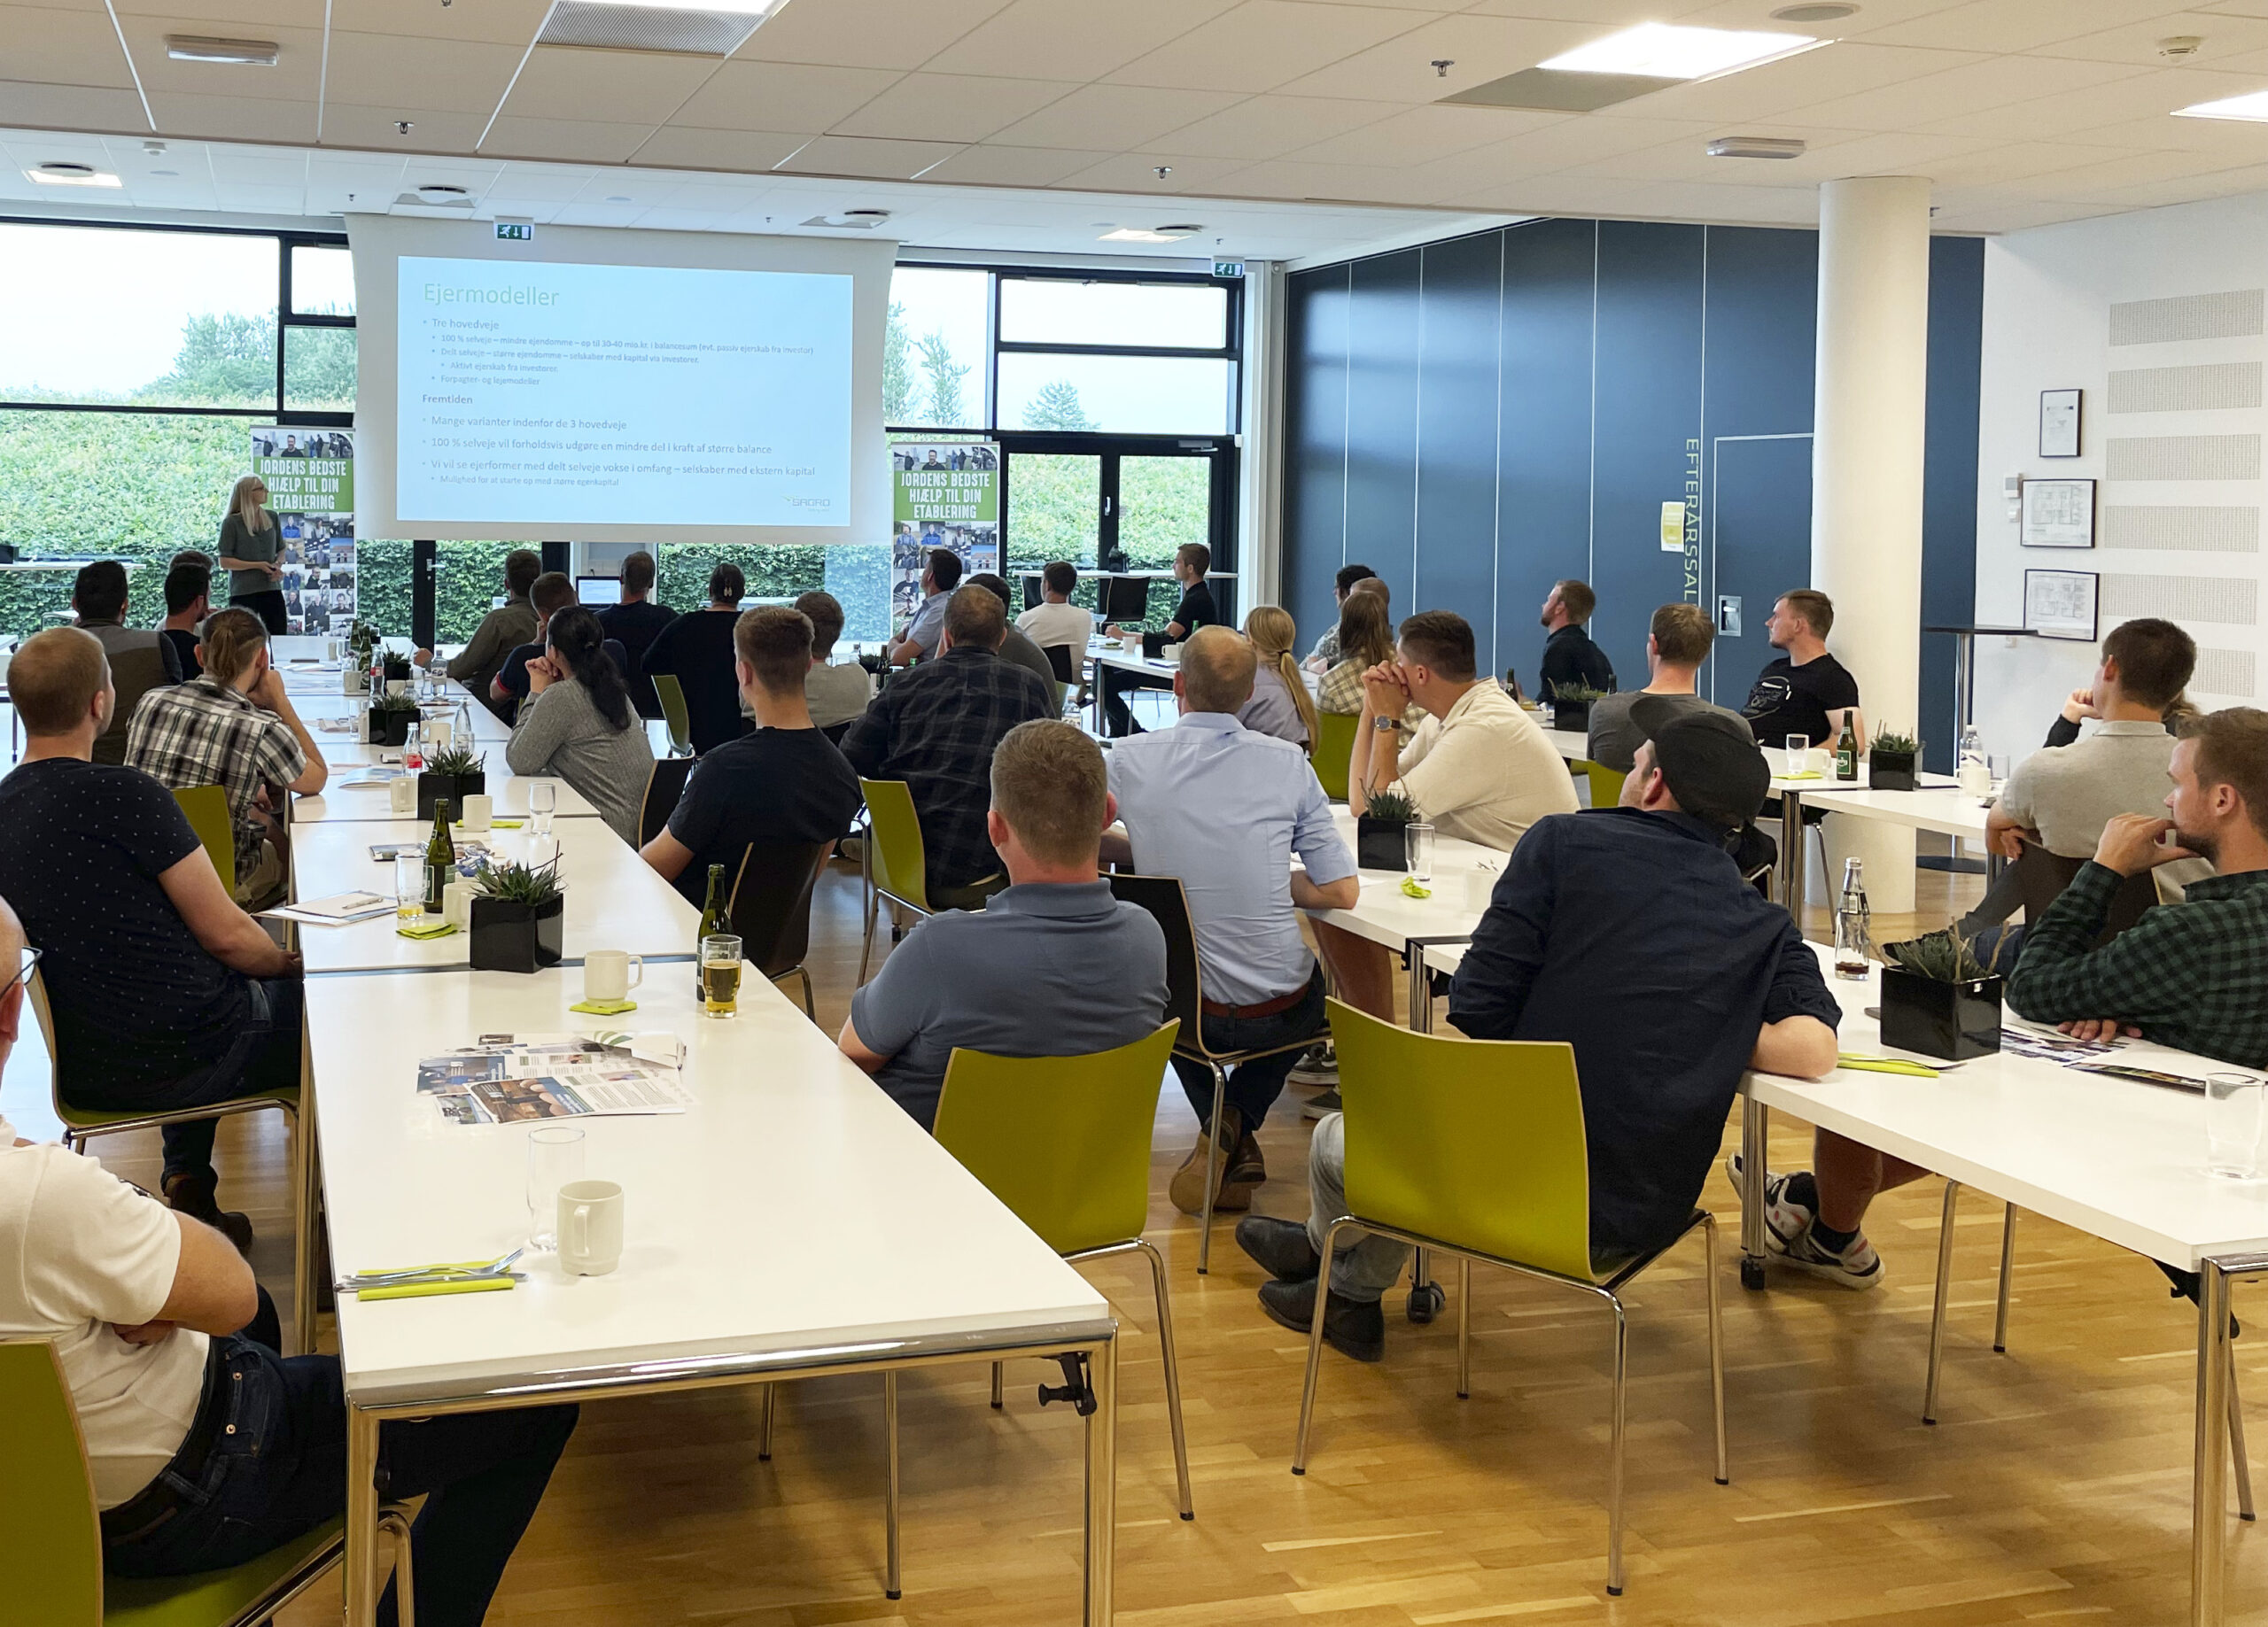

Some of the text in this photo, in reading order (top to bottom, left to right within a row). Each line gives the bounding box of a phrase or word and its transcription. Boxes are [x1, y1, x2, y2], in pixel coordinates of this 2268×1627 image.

[424, 283, 560, 306] Ejermodeller
[432, 319, 500, 332] Tre hovedveje
[466, 336, 492, 346] selveje
[529, 337, 573, 346] ejendomme
[655, 342, 697, 351] balancesum
[740, 345, 770, 353] ejerskab
[422, 394, 473, 404] Fremtiden
[431, 416, 465, 427] Mange
[468, 417, 510, 426] varianter
[513, 418, 554, 428] indenfor
[555, 418, 568, 428] de
[579, 419, 626, 431] hovedveje
[431, 438, 449, 447] 100
[452, 438, 461, 447] %
[463, 438, 496, 449] selveje
[498, 439, 509, 448] vil
[512, 439, 563, 449] forholdsvis
[566, 441, 599, 452] udgøre
[616, 442, 649, 451] mindre
[651, 443, 665, 452] del
[673, 443, 695, 452] kraft
[696, 444, 706, 453] af
[708, 445, 734, 453] større
[737, 445, 773, 453] balance
[260, 459, 346, 476] JORDENS BEDSTE
[431, 460, 441, 469] Vi
[443, 460, 454, 469] vil
[470, 461, 522, 471] ejerformer
[524, 461, 545, 470] med
[548, 461, 566, 471] delt
[569, 462, 601, 473] selveje
[603, 462, 630, 472] vokse
[637, 463, 672, 475] omfang
[682, 465, 725, 474] selskaber
[727, 466, 748, 475] med
[750, 466, 783, 476] ekstern
[785, 467, 815, 476] kapital
[268, 476, 339, 493] HJÆLP TIL DIN
[901, 472, 990, 487] JORDENS BEDSTE
[273, 494, 335, 510] ETABLERING
[909, 488, 982, 503] HJÆLP TIL DIN
[913, 504, 977, 519] ETABLERING
[1684, 438, 1700, 608] EFTERÅRSSAL
